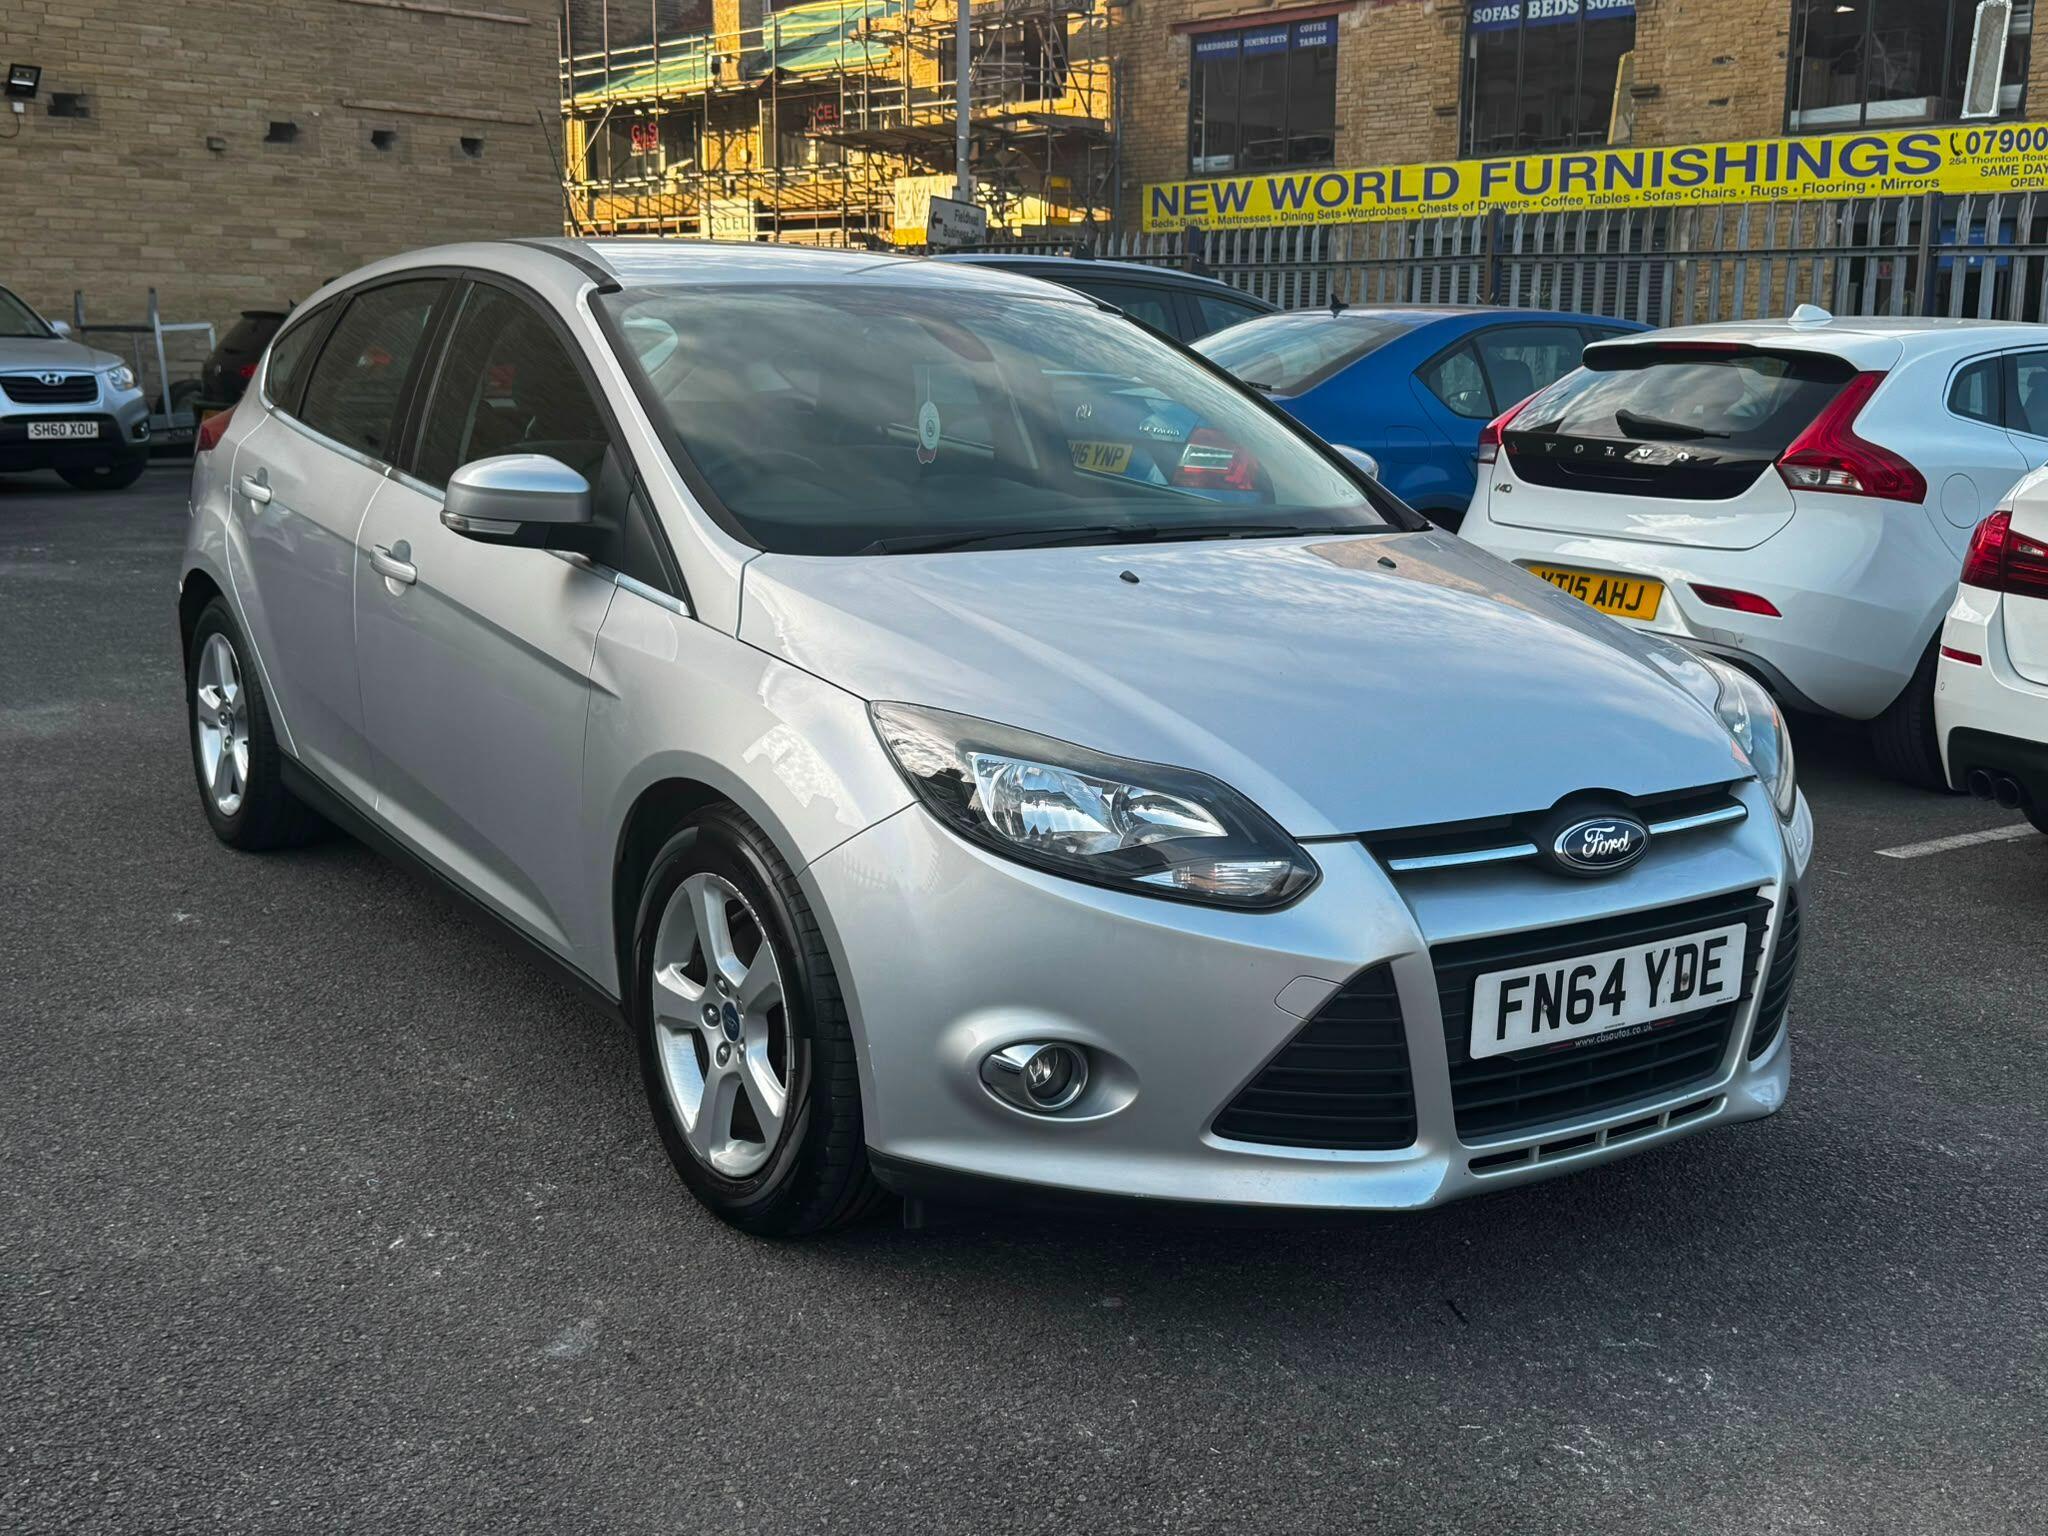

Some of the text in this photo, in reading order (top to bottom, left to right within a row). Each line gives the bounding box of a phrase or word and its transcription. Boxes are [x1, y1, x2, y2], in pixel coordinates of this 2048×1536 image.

[1472, 4, 1521, 24] SOFAS
[1526, 0, 1580, 19] BEDS
[1299, 21, 1328, 33] COFFEE
[1196, 33, 1288, 52] WARDROBES DINING SETS
[1299, 35, 1327, 47] TABLES
[1965, 127, 2048, 155] 07900
[1971, 155, 2019, 165] Thornton
[1980, 163, 2048, 177] SAME DAY
[1151, 133, 1941, 217] NEW WORLD FURNISHINGS
[2010, 177, 2045, 188] OPEN
[1151, 177, 1940, 229] Beds Bunks Mattresses Dining Sets Wardrobes Chests of Drawers Coffee Tables Sofas Chairs Rugs Flooring Mirrors
[34, 423, 93, 436] SH60 XOU
[1092, 444, 1125, 467] YNP
[1544, 442, 1690, 462] VOLVO
[1592, 579, 1645, 611] AHJ
[1582, 826, 1631, 858] Ford
[1497, 936, 1728, 1040] FN64 YDE
[1574, 1021, 1653, 1048] www.cbsautos.co.uk
